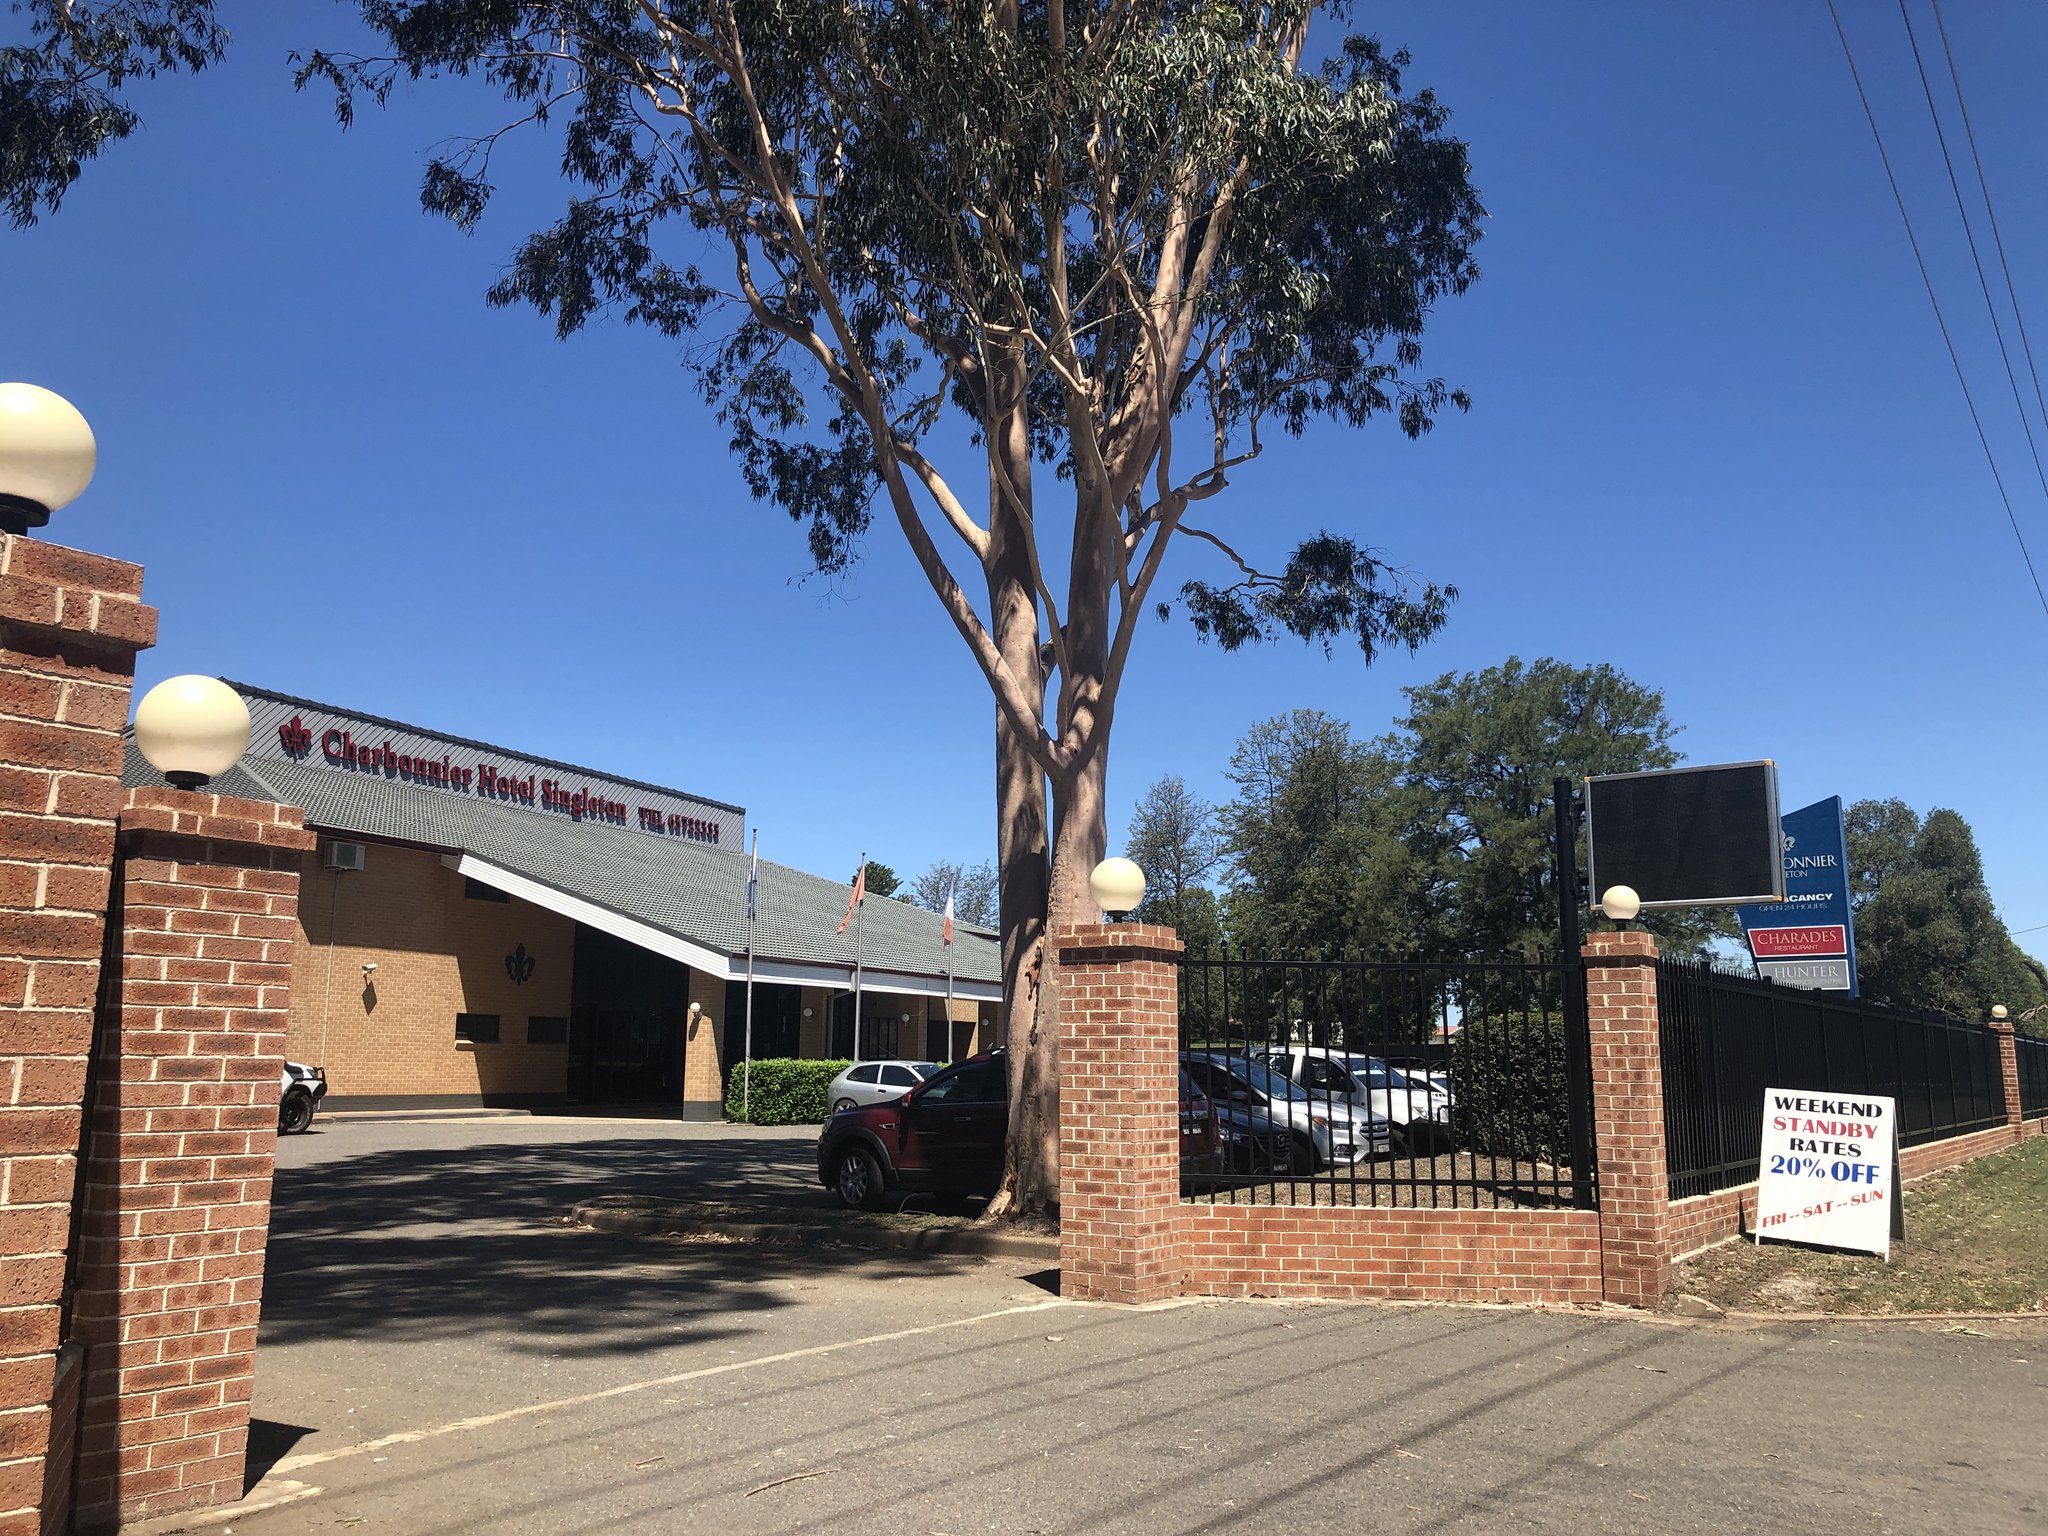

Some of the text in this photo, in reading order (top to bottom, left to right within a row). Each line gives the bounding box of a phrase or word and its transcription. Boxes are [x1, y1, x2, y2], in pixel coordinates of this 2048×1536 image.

[322, 729, 473, 786] Charbonnier
[478, 763, 536, 800] Hotel
[541, 778, 627, 819] Singleton
[1759, 904, 1784, 912] OPEN
[1757, 930, 1837, 945] CHARADES
[1774, 965, 1839, 978] HUNTER
[1774, 1096, 1883, 1118] WEEKEND
[1773, 1116, 1878, 1139] STANDBY
[1790, 1138, 1862, 1158] RATES
[1770, 1155, 1880, 1184] 20% OFF
